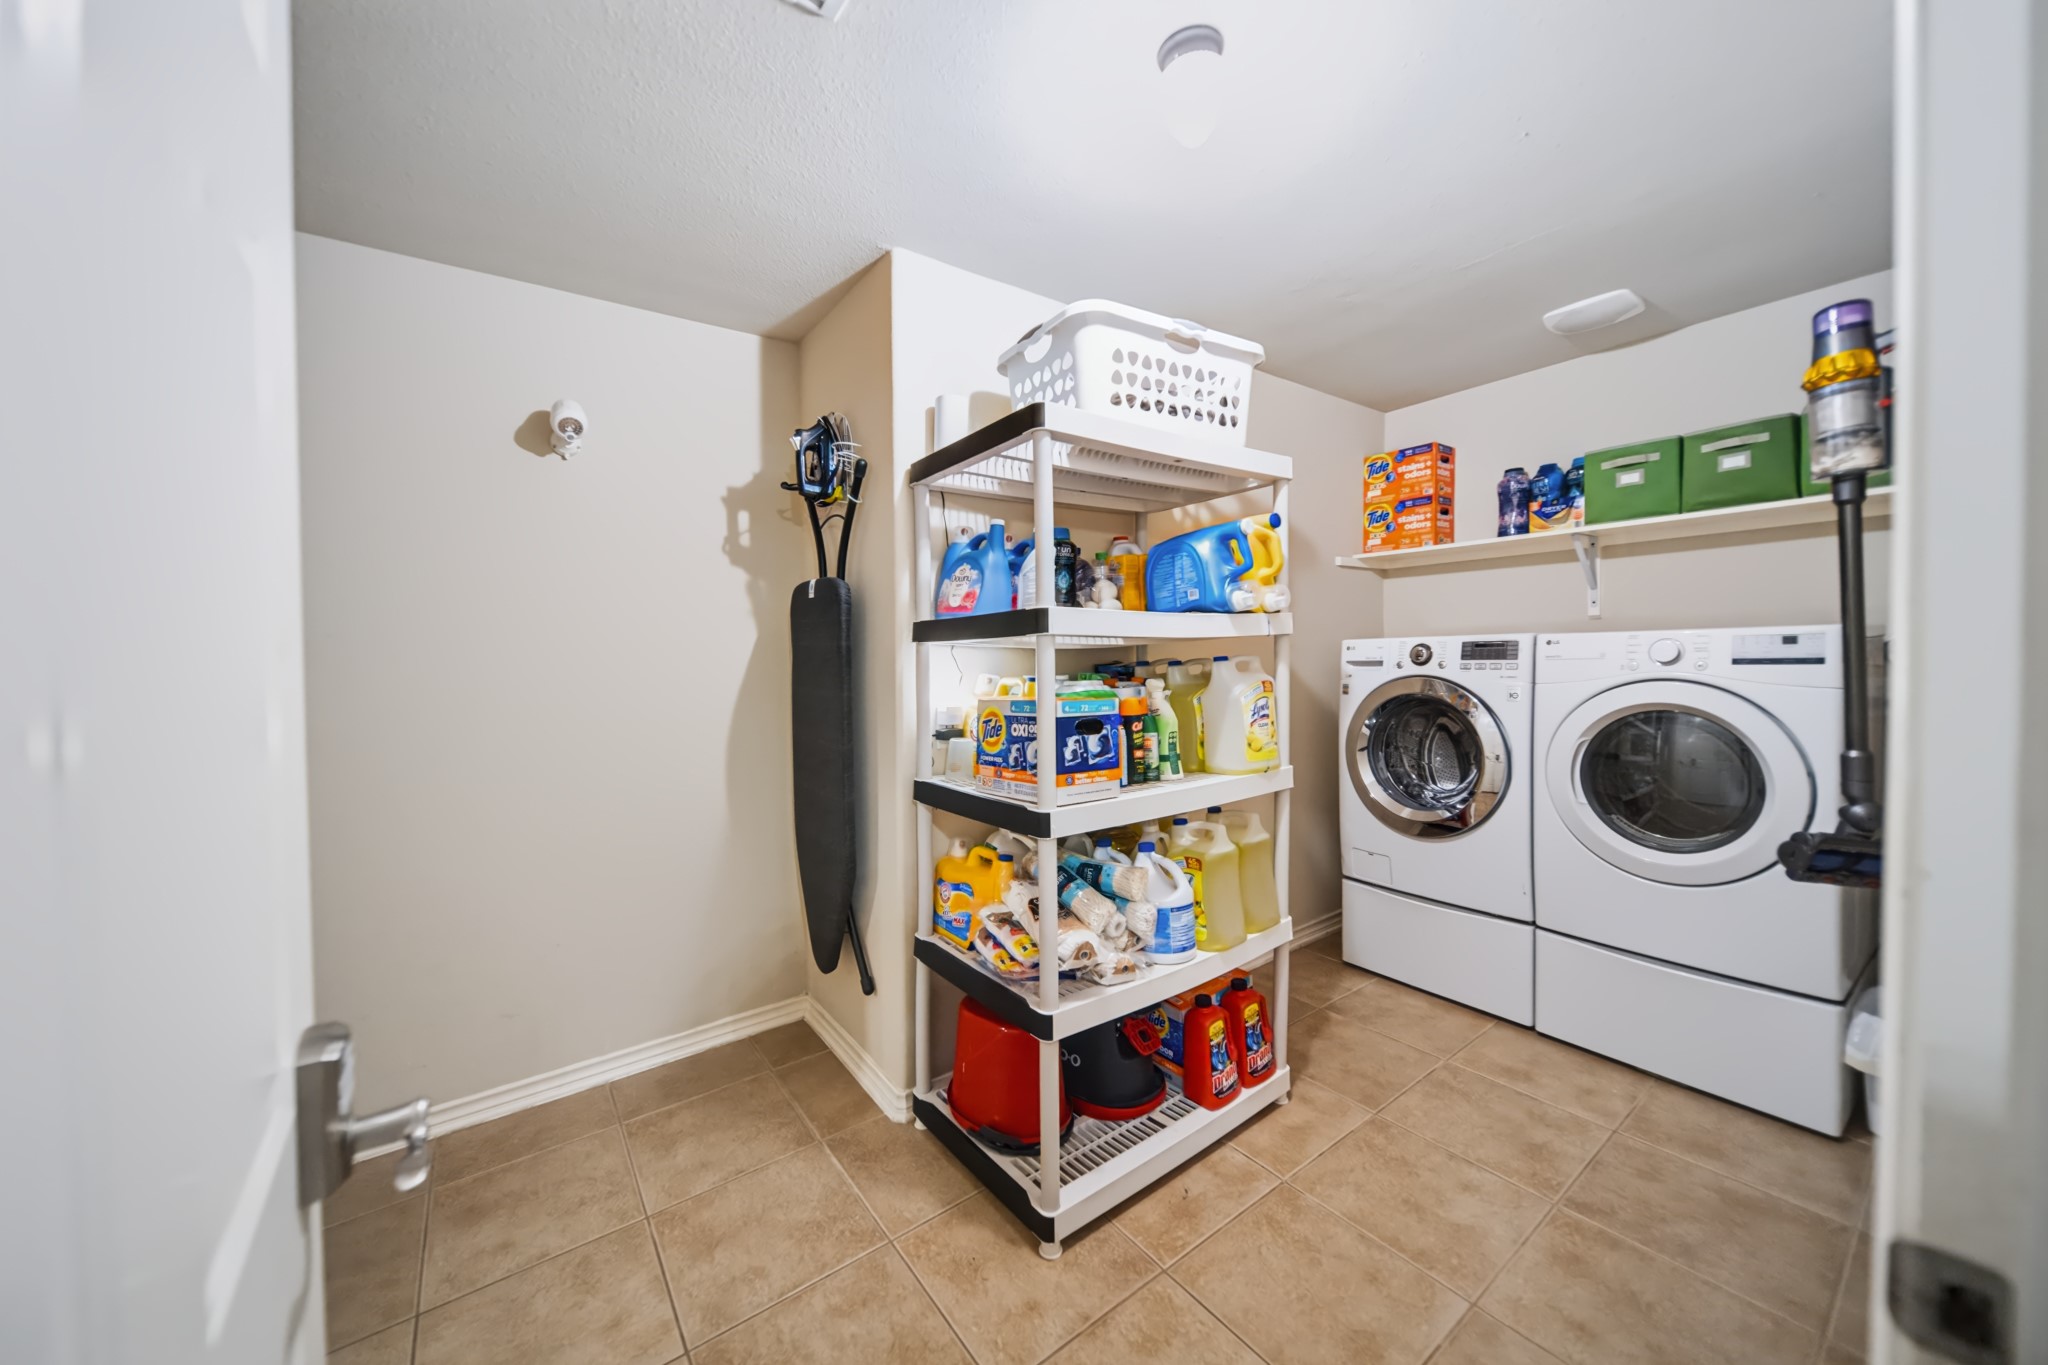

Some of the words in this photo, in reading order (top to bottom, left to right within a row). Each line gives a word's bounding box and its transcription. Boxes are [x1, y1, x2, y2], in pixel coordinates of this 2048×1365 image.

[1367, 460, 1390, 480] Tide
[1397, 462, 1425, 473] stains
[1403, 468, 1432, 479] odors
[1367, 509, 1390, 528] Tide
[1397, 514, 1425, 524] stains
[1403, 520, 1432, 531] odors
[951, 574, 972, 586] Downy
[1080, 704, 1089, 712] 72
[982, 718, 1003, 743] Tide
[1011, 723, 1029, 737] OXI
